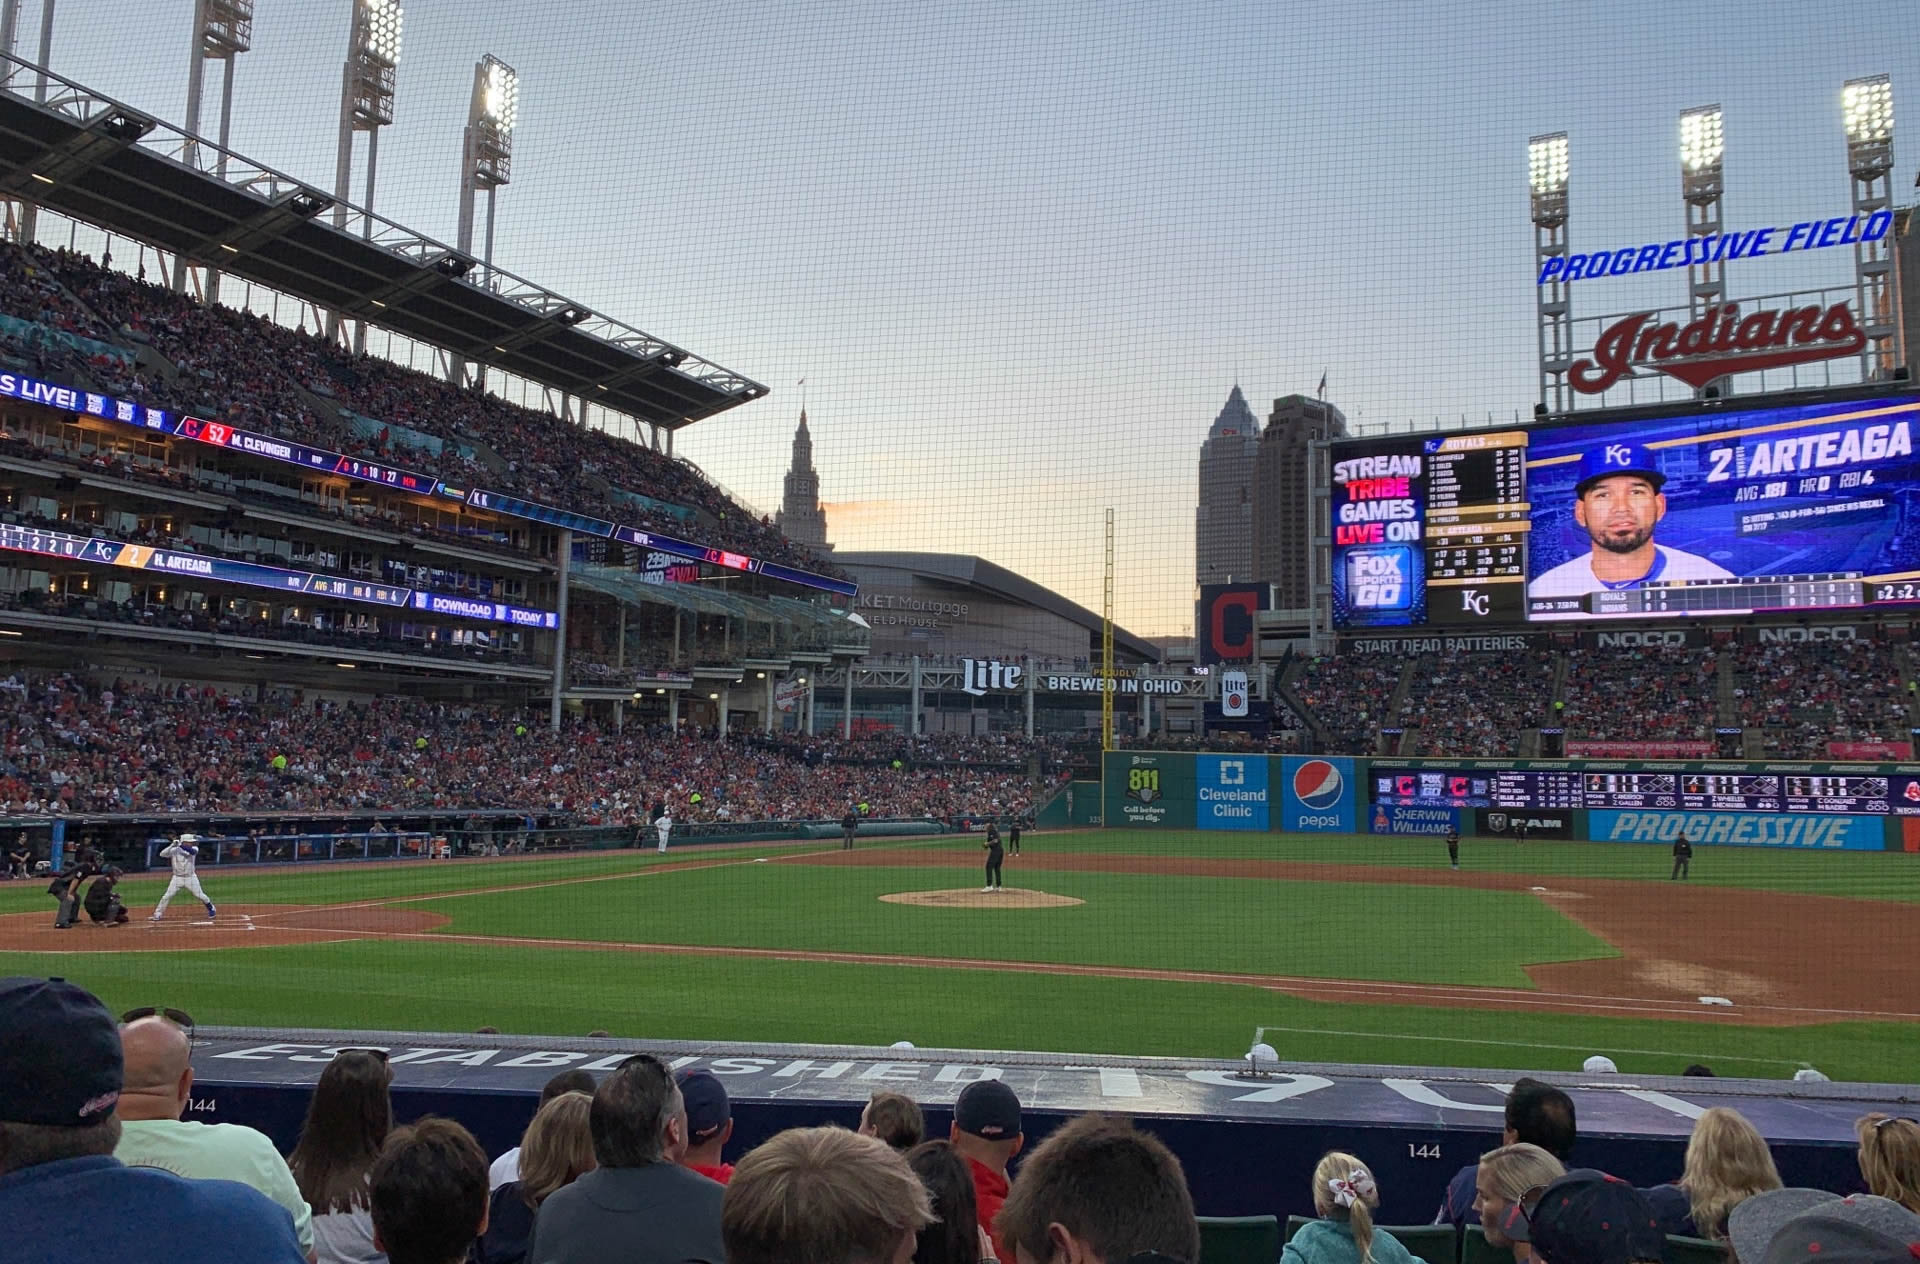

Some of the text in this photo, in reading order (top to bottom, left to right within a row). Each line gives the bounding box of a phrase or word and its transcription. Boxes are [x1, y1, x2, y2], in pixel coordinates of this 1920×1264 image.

[1537, 211, 1893, 286] PROGRESSIVE FIELD
[1568, 298, 1866, 394] Indians
[21, 379, 77, 408] LIVE!
[209, 425, 224, 443] 52
[244, 438, 291, 459] CLEVINGER
[1446, 438, 1486, 450] ROYALS
[1605, 444, 1631, 466] KC
[1707, 422, 1912, 483] 2 ARTEAGA
[353, 463, 358, 473] 9
[370, 467, 378, 478] 18
[388, 471, 397, 482] 27
[1334, 455, 1422, 483] STREAM
[1345, 477, 1410, 501] TRIBE
[1735, 469, 1875, 503] AVG .181 HR 0 RBI 4
[1340, 500, 1416, 523] GAMES
[1337, 521, 1420, 545] LIVE ON
[32, 537, 73, 554] 2 2 0
[95, 542, 138, 564] KC 2
[153, 553, 212, 574] H. ARTEAGA
[1355, 555, 1400, 576] FOX
[1355, 575, 1403, 586] SPORTS
[314, 580, 328, 591] AVG
[330, 581, 346, 594] .181
[365, 587, 371, 598] 0
[391, 591, 396, 602] 4
[1355, 584, 1400, 607] GO
[1600, 592, 1627, 601] ROYALS
[1878, 585, 1914, 600] B 2 S 2
[433, 598, 491, 615] DOWNLOAD
[511, 610, 541, 623] TODAY
[900, 596, 969, 617] Mortgage
[1462, 590, 1489, 615] KC
[1211, 592, 1258, 657] C
[1759, 626, 1856, 643] NOCO
[1354, 636, 1530, 653] START DEAD BATTERIES.
[1598, 631, 1686, 648] NOCO
[961, 658, 1023, 696] Lite
[1049, 677, 1182, 694] BREWED IN OHIO
[1224, 680, 1246, 693] Lite
[1129, 769, 1159, 791] 811
[1398, 776, 1413, 796] C
[1421, 774, 1441, 784] FOX
[1451, 777, 1467, 797] C
[1199, 788, 1266, 801] Cleveland
[1422, 787, 1441, 796] GO
[1139, 806, 1165, 814] before
[1213, 804, 1252, 817] Clinic
[1393, 808, 1451, 820] SHERWIN
[1299, 815, 1340, 829] pepsi
[1392, 821, 1450, 834] WILLIAMS
[1609, 812, 1853, 848] PROGRESSIVE
[188, 1099, 216, 1112] 144
[1408, 1144, 1441, 1159] 144
